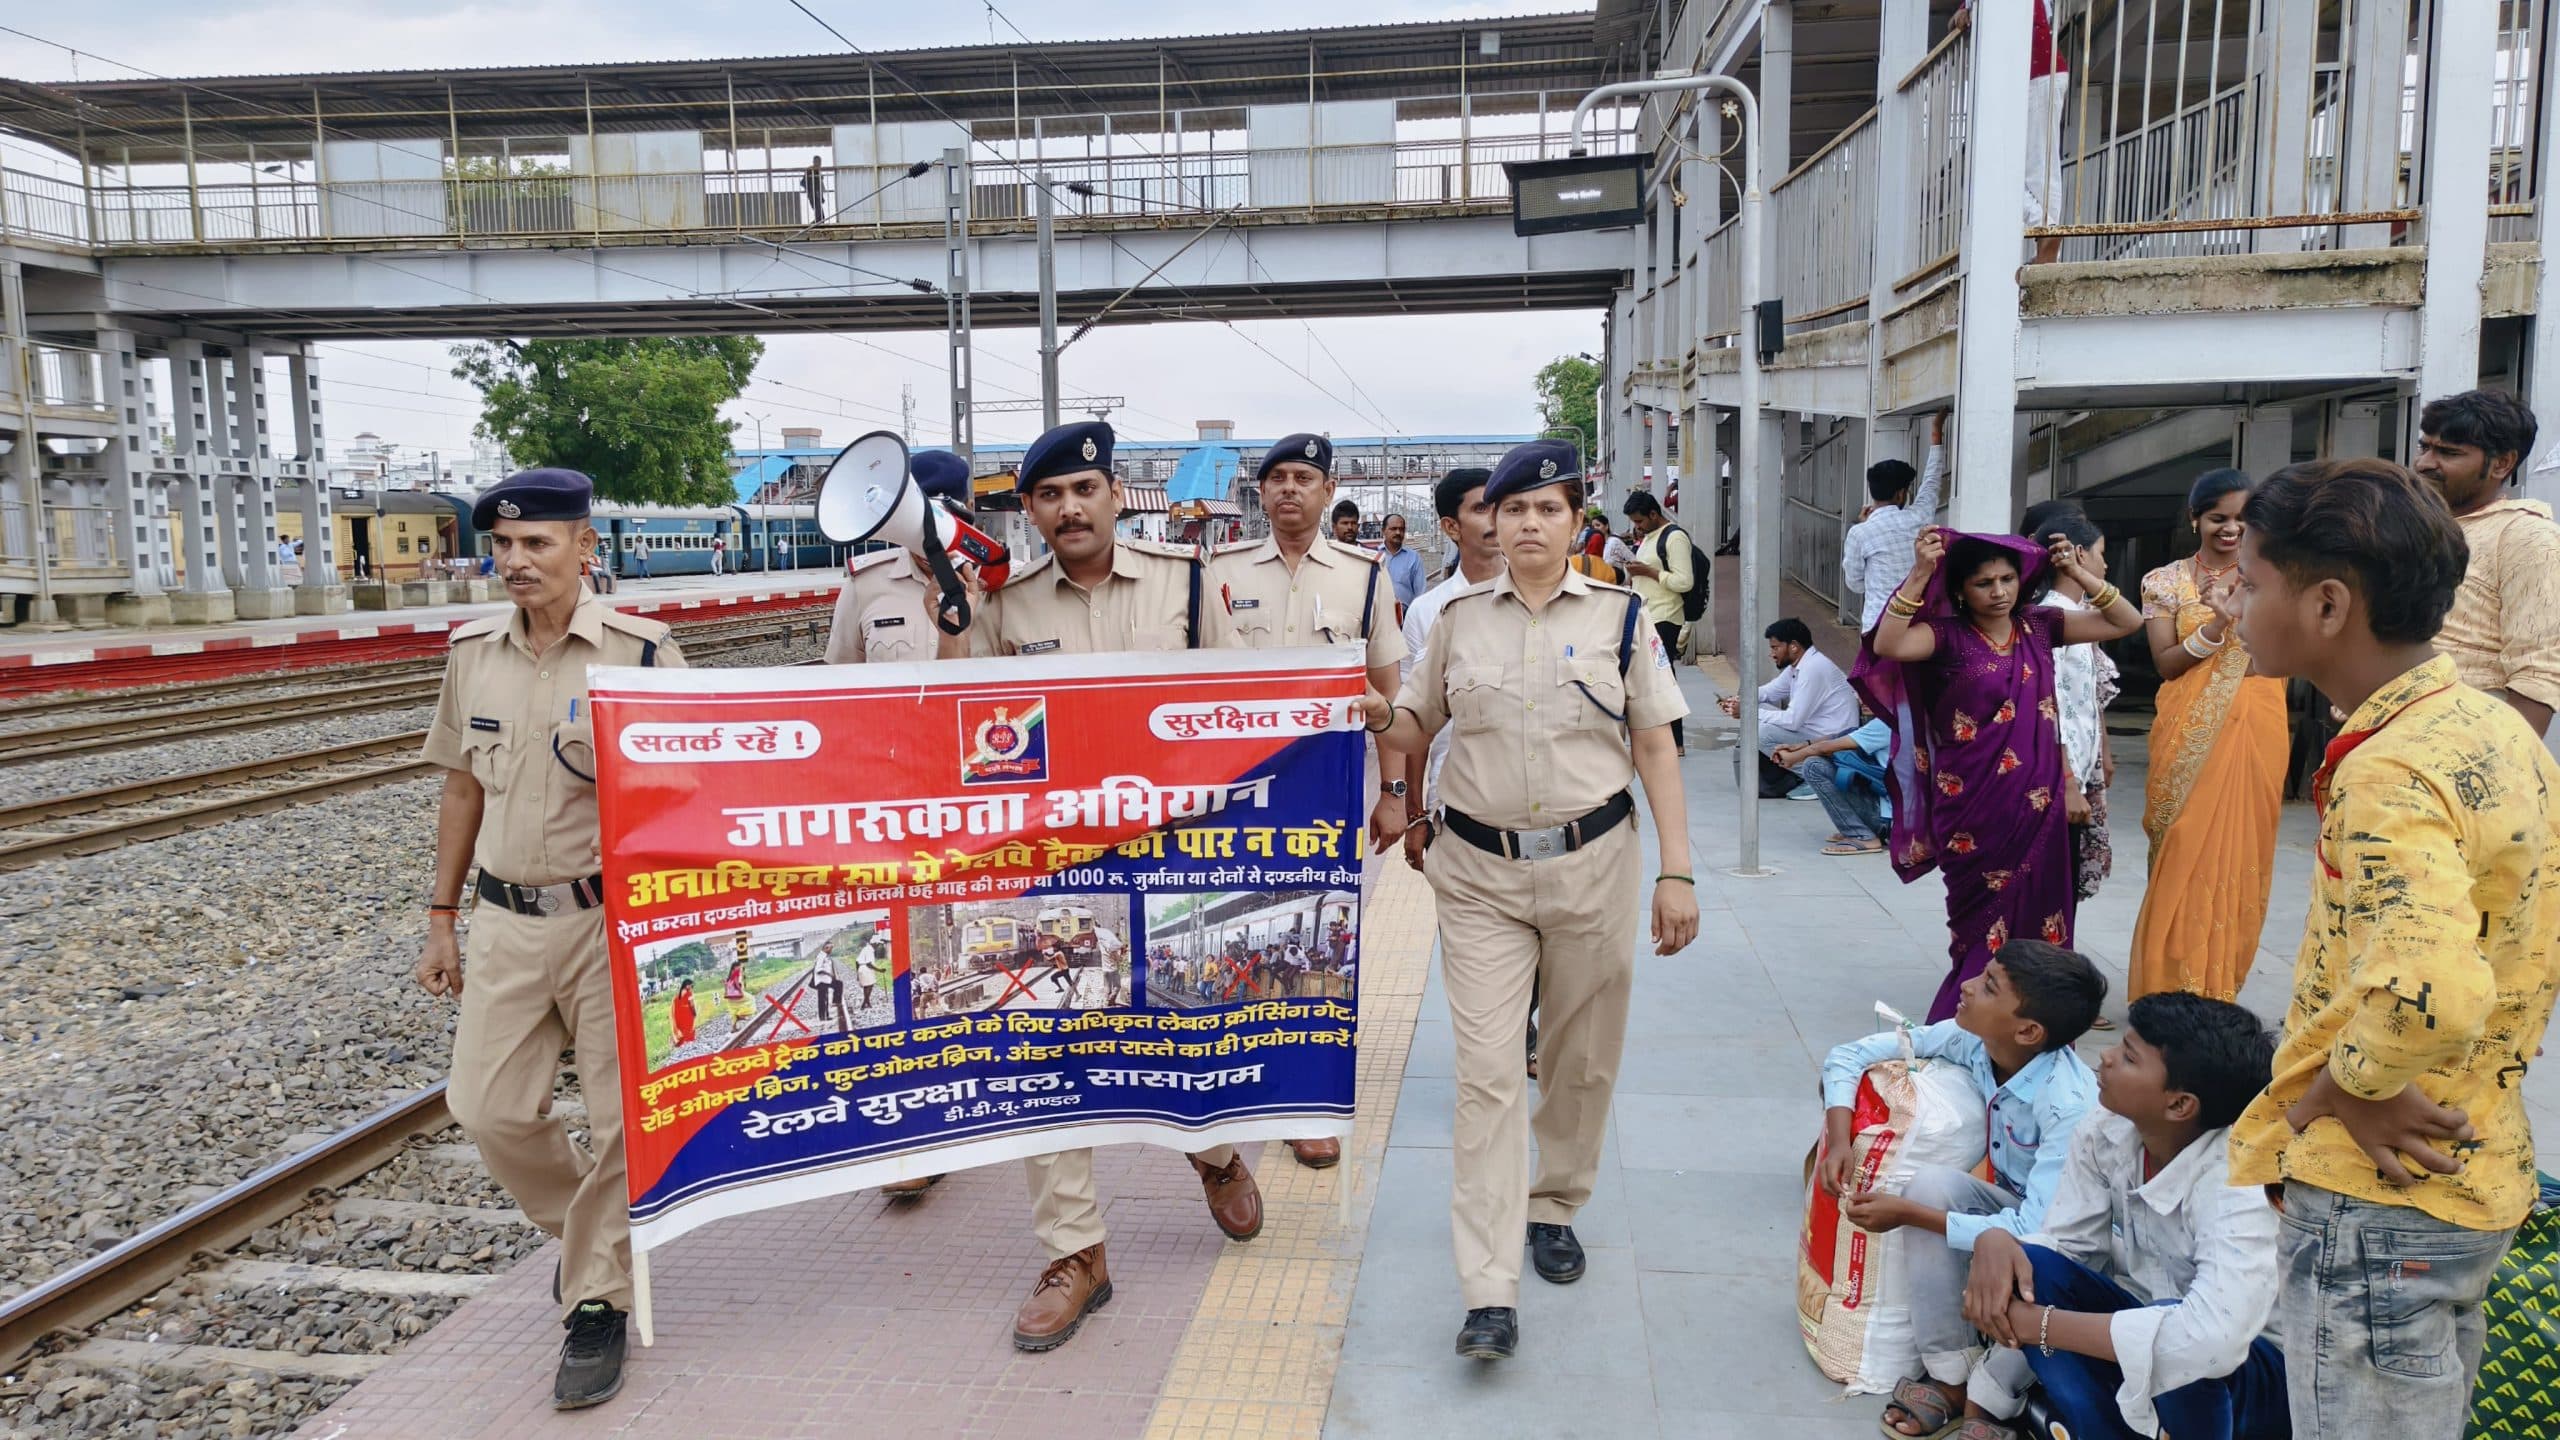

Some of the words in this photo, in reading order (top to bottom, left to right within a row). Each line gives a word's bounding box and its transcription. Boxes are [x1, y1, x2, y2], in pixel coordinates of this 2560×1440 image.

[630, 728, 724, 752] सतर्क
[734, 726, 779, 754] रहें
[794, 731, 806, 750] !
[1163, 705, 1280, 737] सुरक्षित
[1289, 703, 1333, 729] रहें
[721, 793, 1030, 847] जागरूकता
[1044, 774, 1277, 828] अभियान
[1174, 827, 1237, 858] पार
[1244, 827, 1276, 859] न
[1282, 819, 1346, 858] करें
[617, 920, 648, 944] ऐसा
[652, 912, 701, 933] करना
[704, 899, 771, 926] दण्डनीय
[775, 893, 831, 914] अपराध
[936, 880, 967, 898] माह
[970, 874, 993, 893] की
[996, 876, 1030, 891] सजा
[1034, 874, 1053, 888] या
[1056, 868, 1104, 887] 1000
[1132, 866, 1184, 891] जुर्माना
[1187, 872, 1206, 886] या
[1209, 865, 1245, 886] दोनों
[1247, 865, 1261, 884] से
[1264, 866, 1326, 885] दण्डनीय
[639, 1063, 708, 1106] कृपया
[709, 1049, 773, 1078] रेलवे
[823, 1033, 863, 1057] को
[863, 1030, 906, 1049] पार
[912, 1016, 975, 1042] करने
[974, 1013, 1004, 1034] के
[1006, 1012, 1055, 1034] लिए
[1057, 1011, 1154, 1034] अधिकृत
[1157, 1012, 1222, 1032] लेबल
[1224, 1002, 1312, 1029] क्रॉसिंग
[640, 1106, 676, 1135] रोड
[679, 1085, 753, 1117] ओभर
[824, 1064, 870, 1092] फुट
[869, 1055, 944, 1079] ओभर
[1006, 1041, 1066, 1062] अंडर
[1068, 1040, 1118, 1055] पास
[1119, 1037, 1176, 1057] रास्ते
[1178, 1042, 1214, 1058] का
[1215, 1032, 1240, 1056] ही
[1242, 1027, 1308, 1052] प्रयोग
[741, 1095, 850, 1139] रेलवे
[858, 1078, 980, 1125] सुरक्षा
[986, 1070, 1074, 1094] बल,
[1086, 1063, 1265, 1092] सासाराम
[1022, 1094, 1083, 1109] मण्डल
